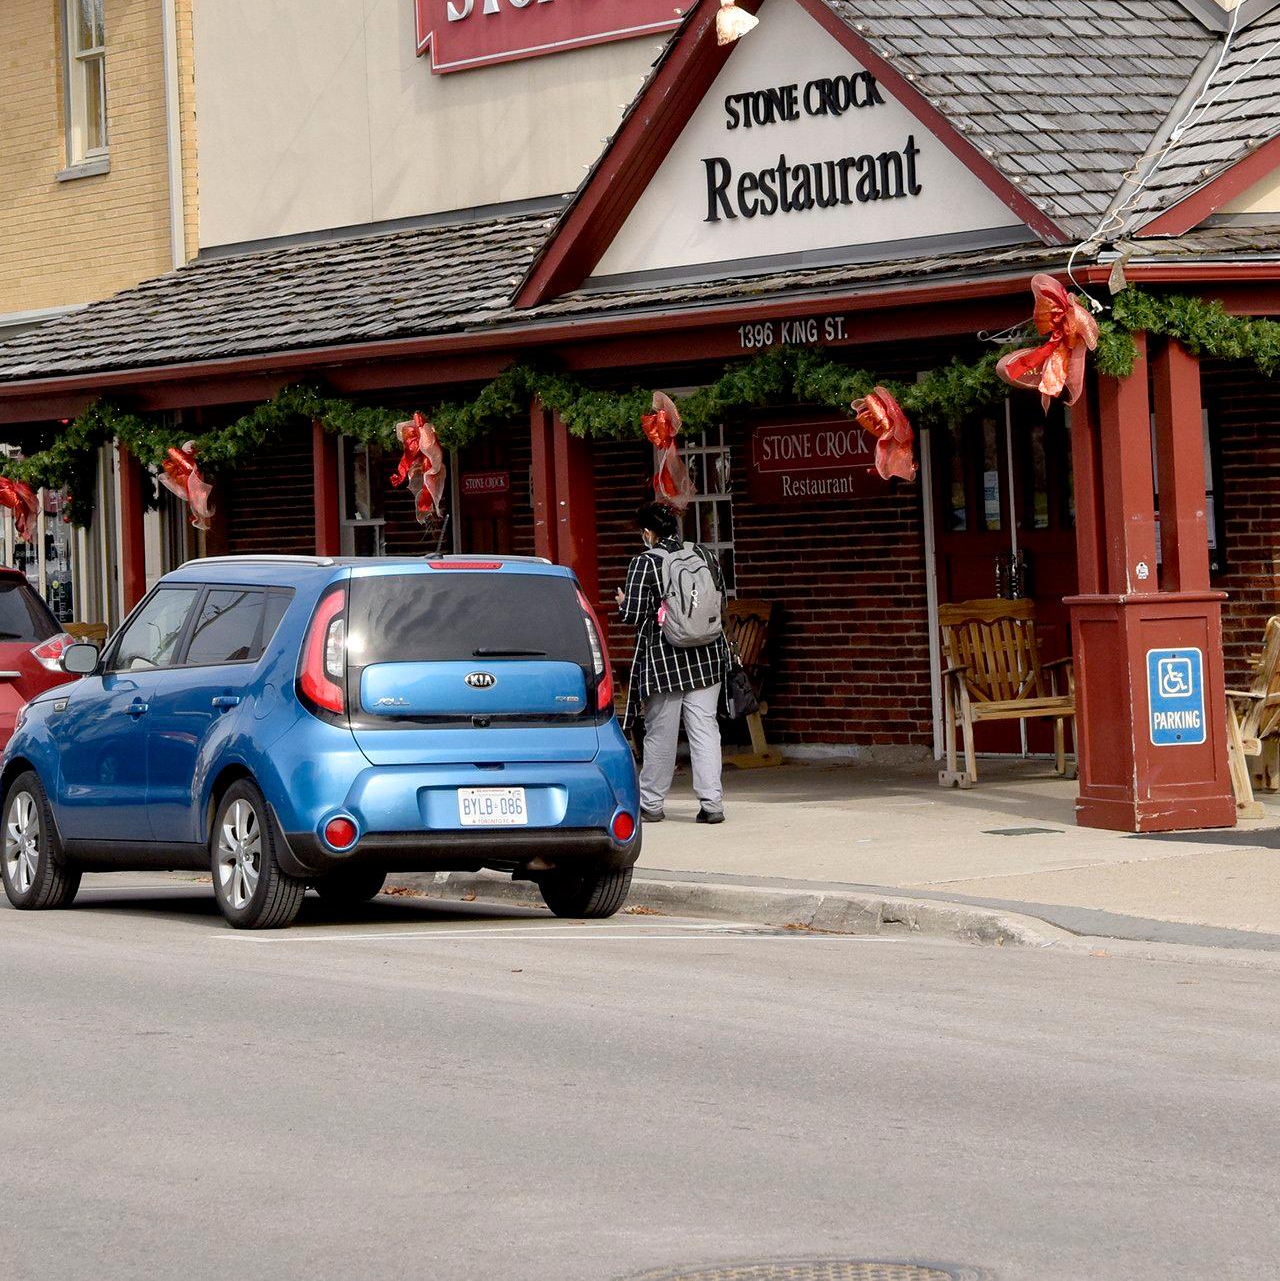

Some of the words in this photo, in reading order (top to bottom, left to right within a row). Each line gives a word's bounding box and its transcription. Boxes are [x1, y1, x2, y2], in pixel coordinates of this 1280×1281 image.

[724, 83, 800, 130] STONE
[803, 71, 886, 116] CROCK
[700, 135, 923, 223] Restaurant
[738, 322, 774, 348] 1396
[781, 319, 818, 344] KING
[824, 317, 849, 341] ST.
[762, 434, 812, 461] STONE
[815, 429, 870, 459] CROCK
[782, 474, 854, 497] Restaurant
[470, 674, 492, 686] KIA
[1154, 710, 1200, 730] PARKING
